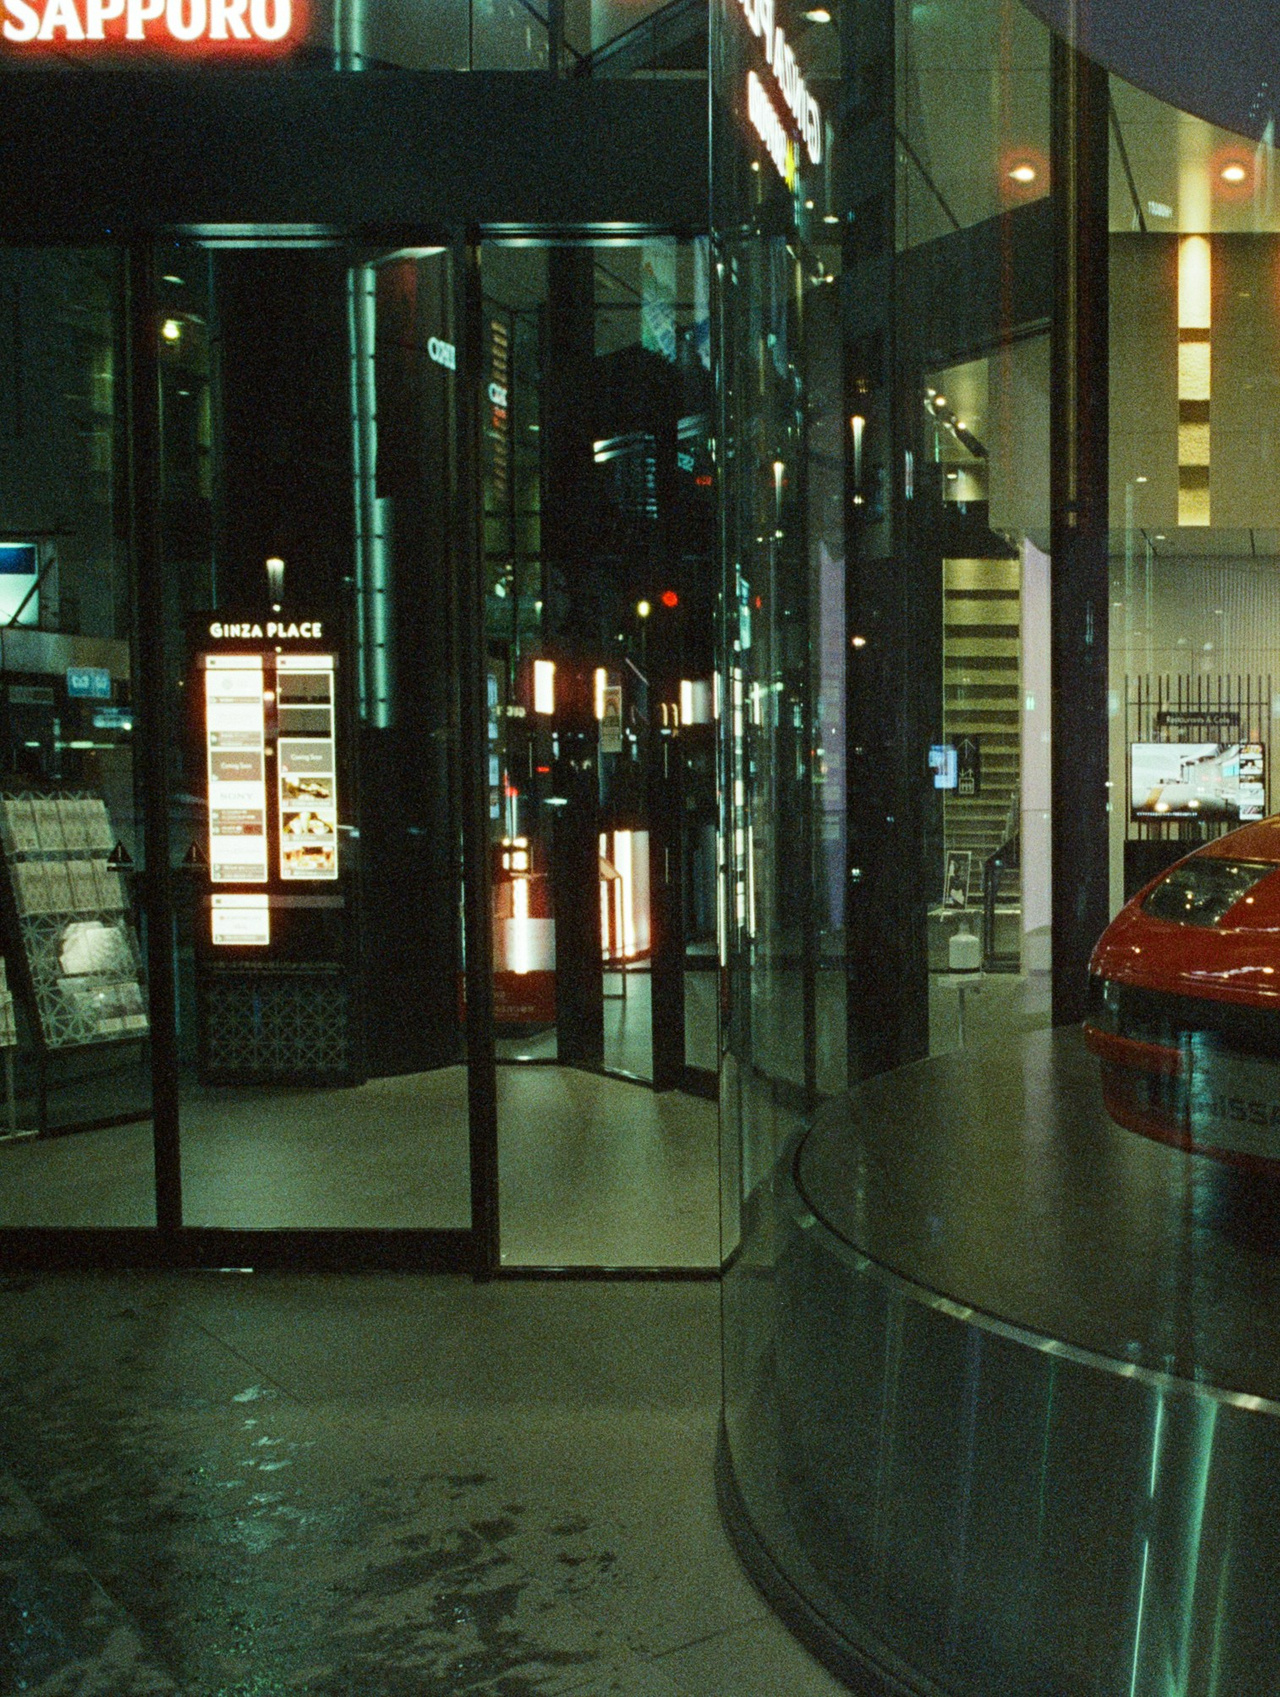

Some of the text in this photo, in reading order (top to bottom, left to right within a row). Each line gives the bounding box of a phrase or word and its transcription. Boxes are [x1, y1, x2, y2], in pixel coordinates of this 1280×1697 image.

[2, 0, 293, 42] SAPPORO
[210, 622, 322, 638] GINZA PLACE
[220, 792, 253, 800] SONY
